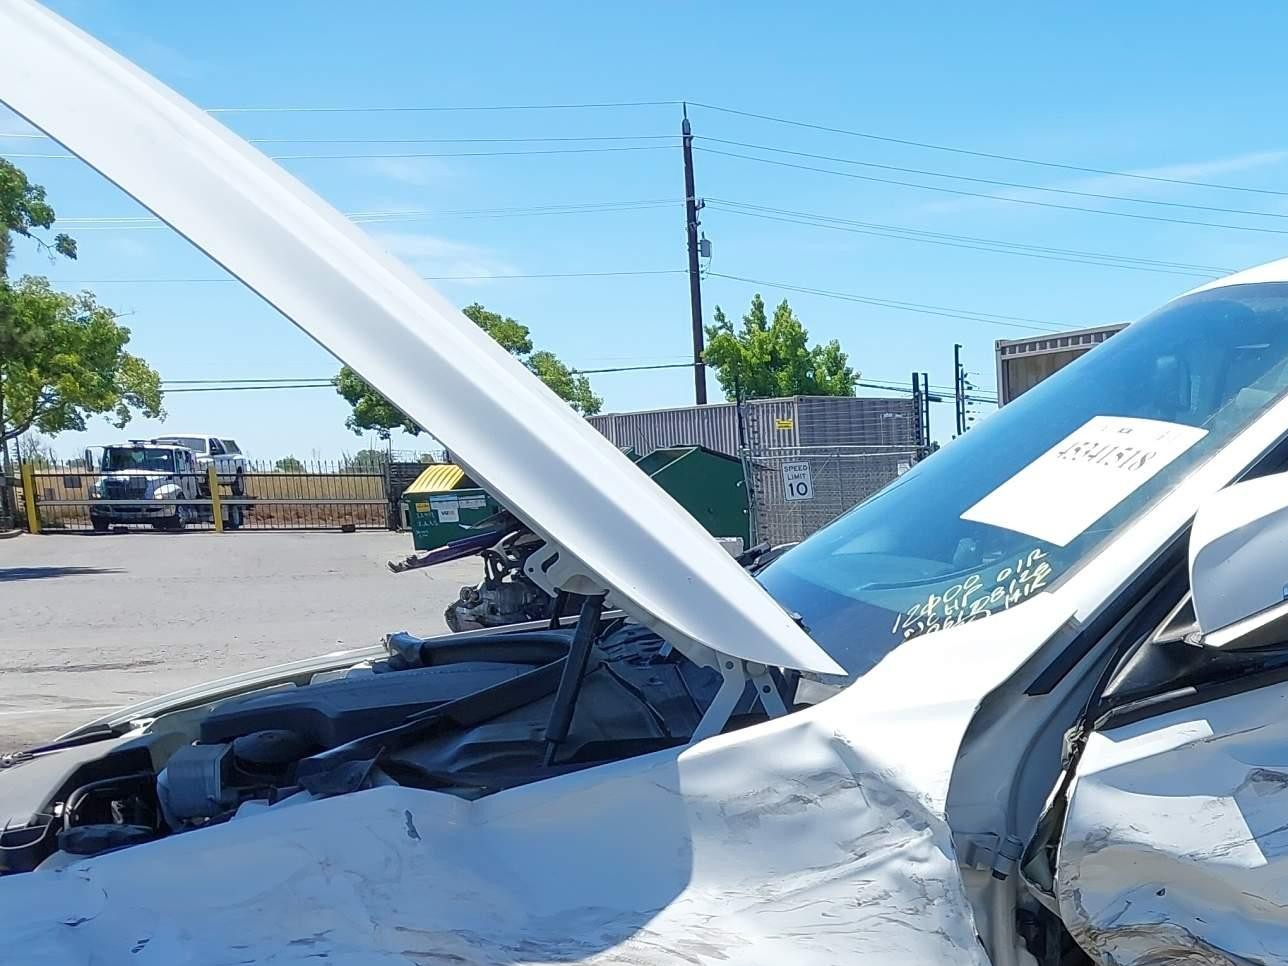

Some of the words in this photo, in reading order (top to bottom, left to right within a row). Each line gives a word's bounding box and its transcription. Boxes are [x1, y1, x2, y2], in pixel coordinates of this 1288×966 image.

[784, 464, 808, 472] SPEED
[787, 473, 807, 481] LIMIT
[789, 482, 808, 497] 10
